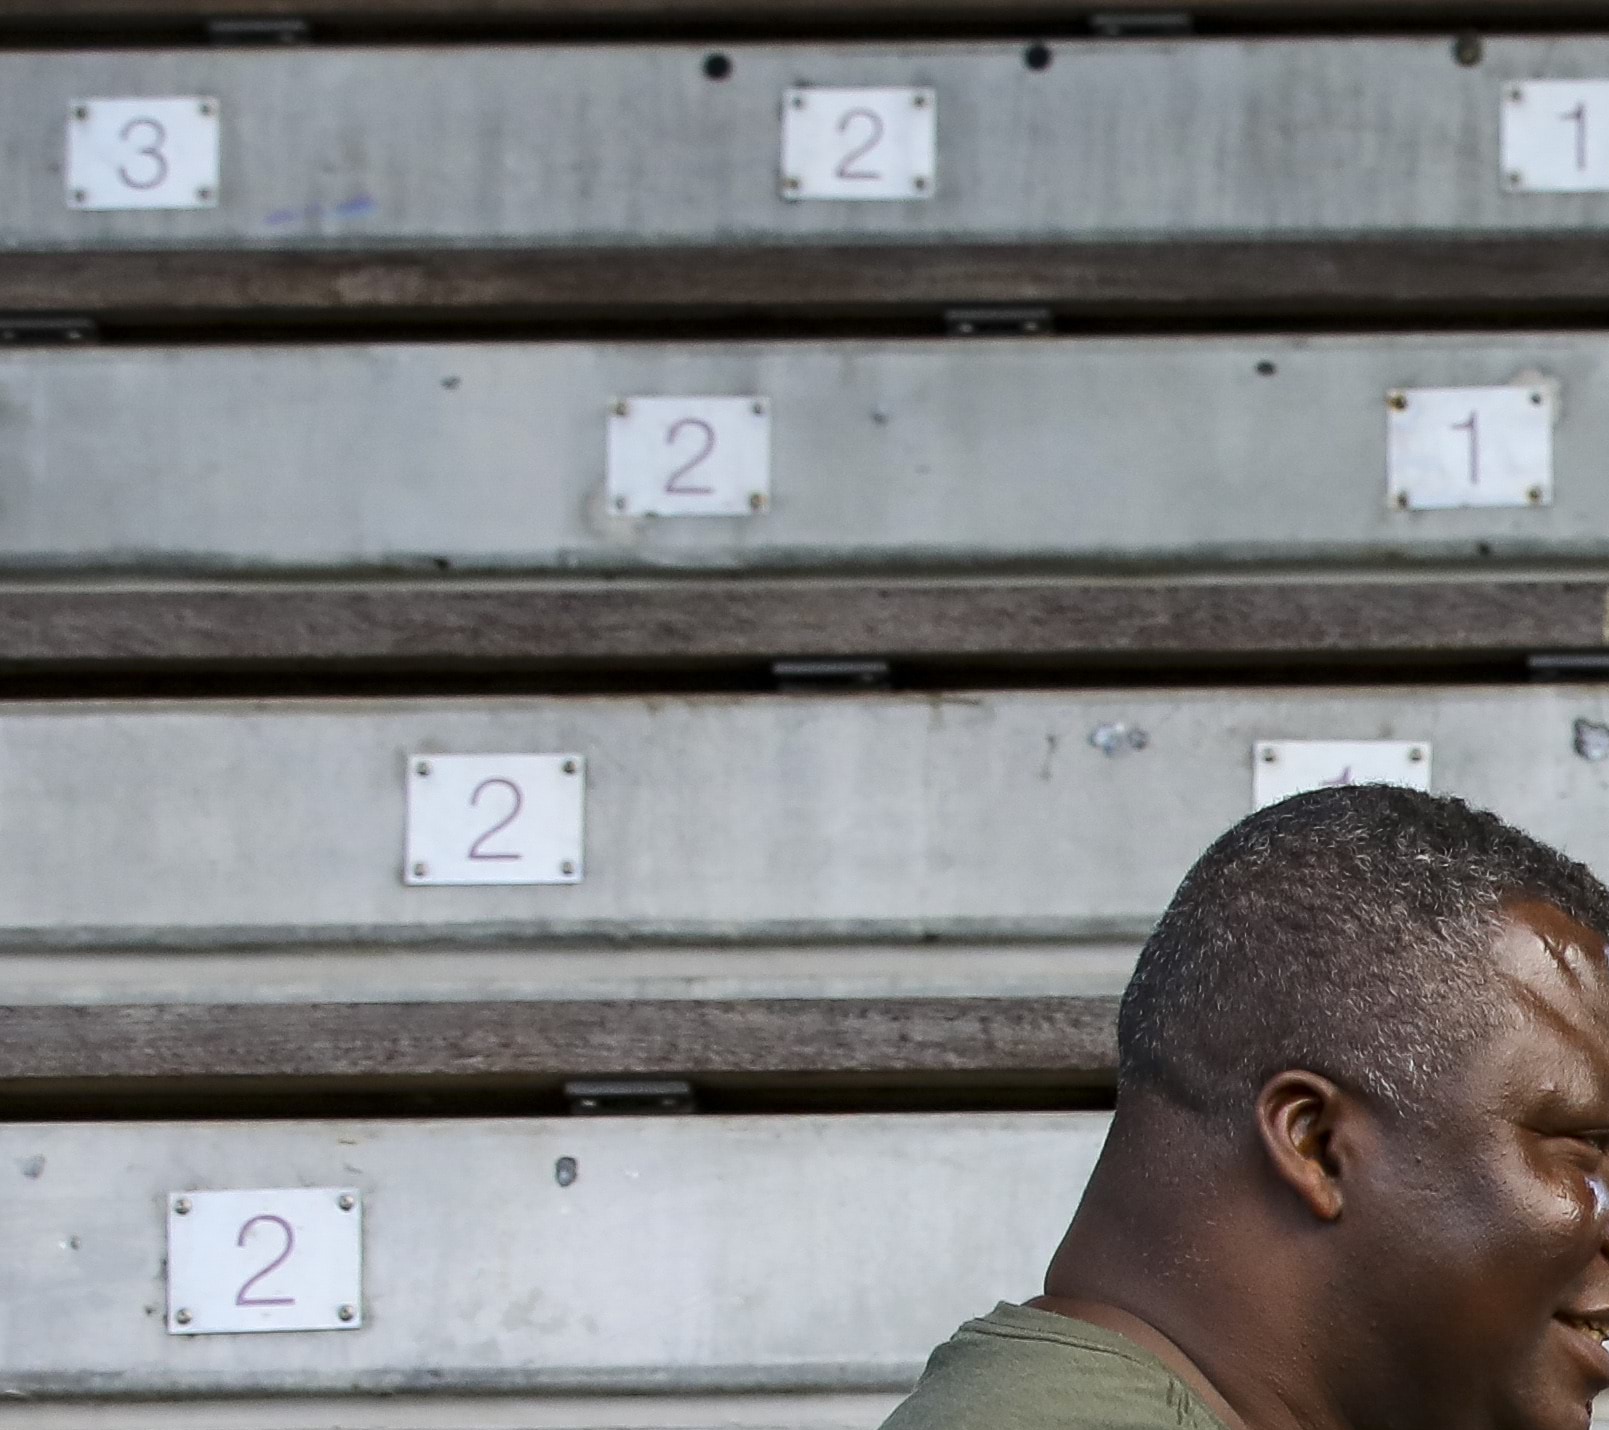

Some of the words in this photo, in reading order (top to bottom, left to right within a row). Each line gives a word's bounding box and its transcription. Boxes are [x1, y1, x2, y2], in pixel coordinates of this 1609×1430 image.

[117, 117, 169, 190] 3
[834, 108, 884, 182] 2
[1558, 101, 1588, 171] 1
[662, 417, 716, 497] 2
[1449, 411, 1480, 485] 1
[467, 777, 524, 862] 2
[235, 1214, 296, 1307] 2
